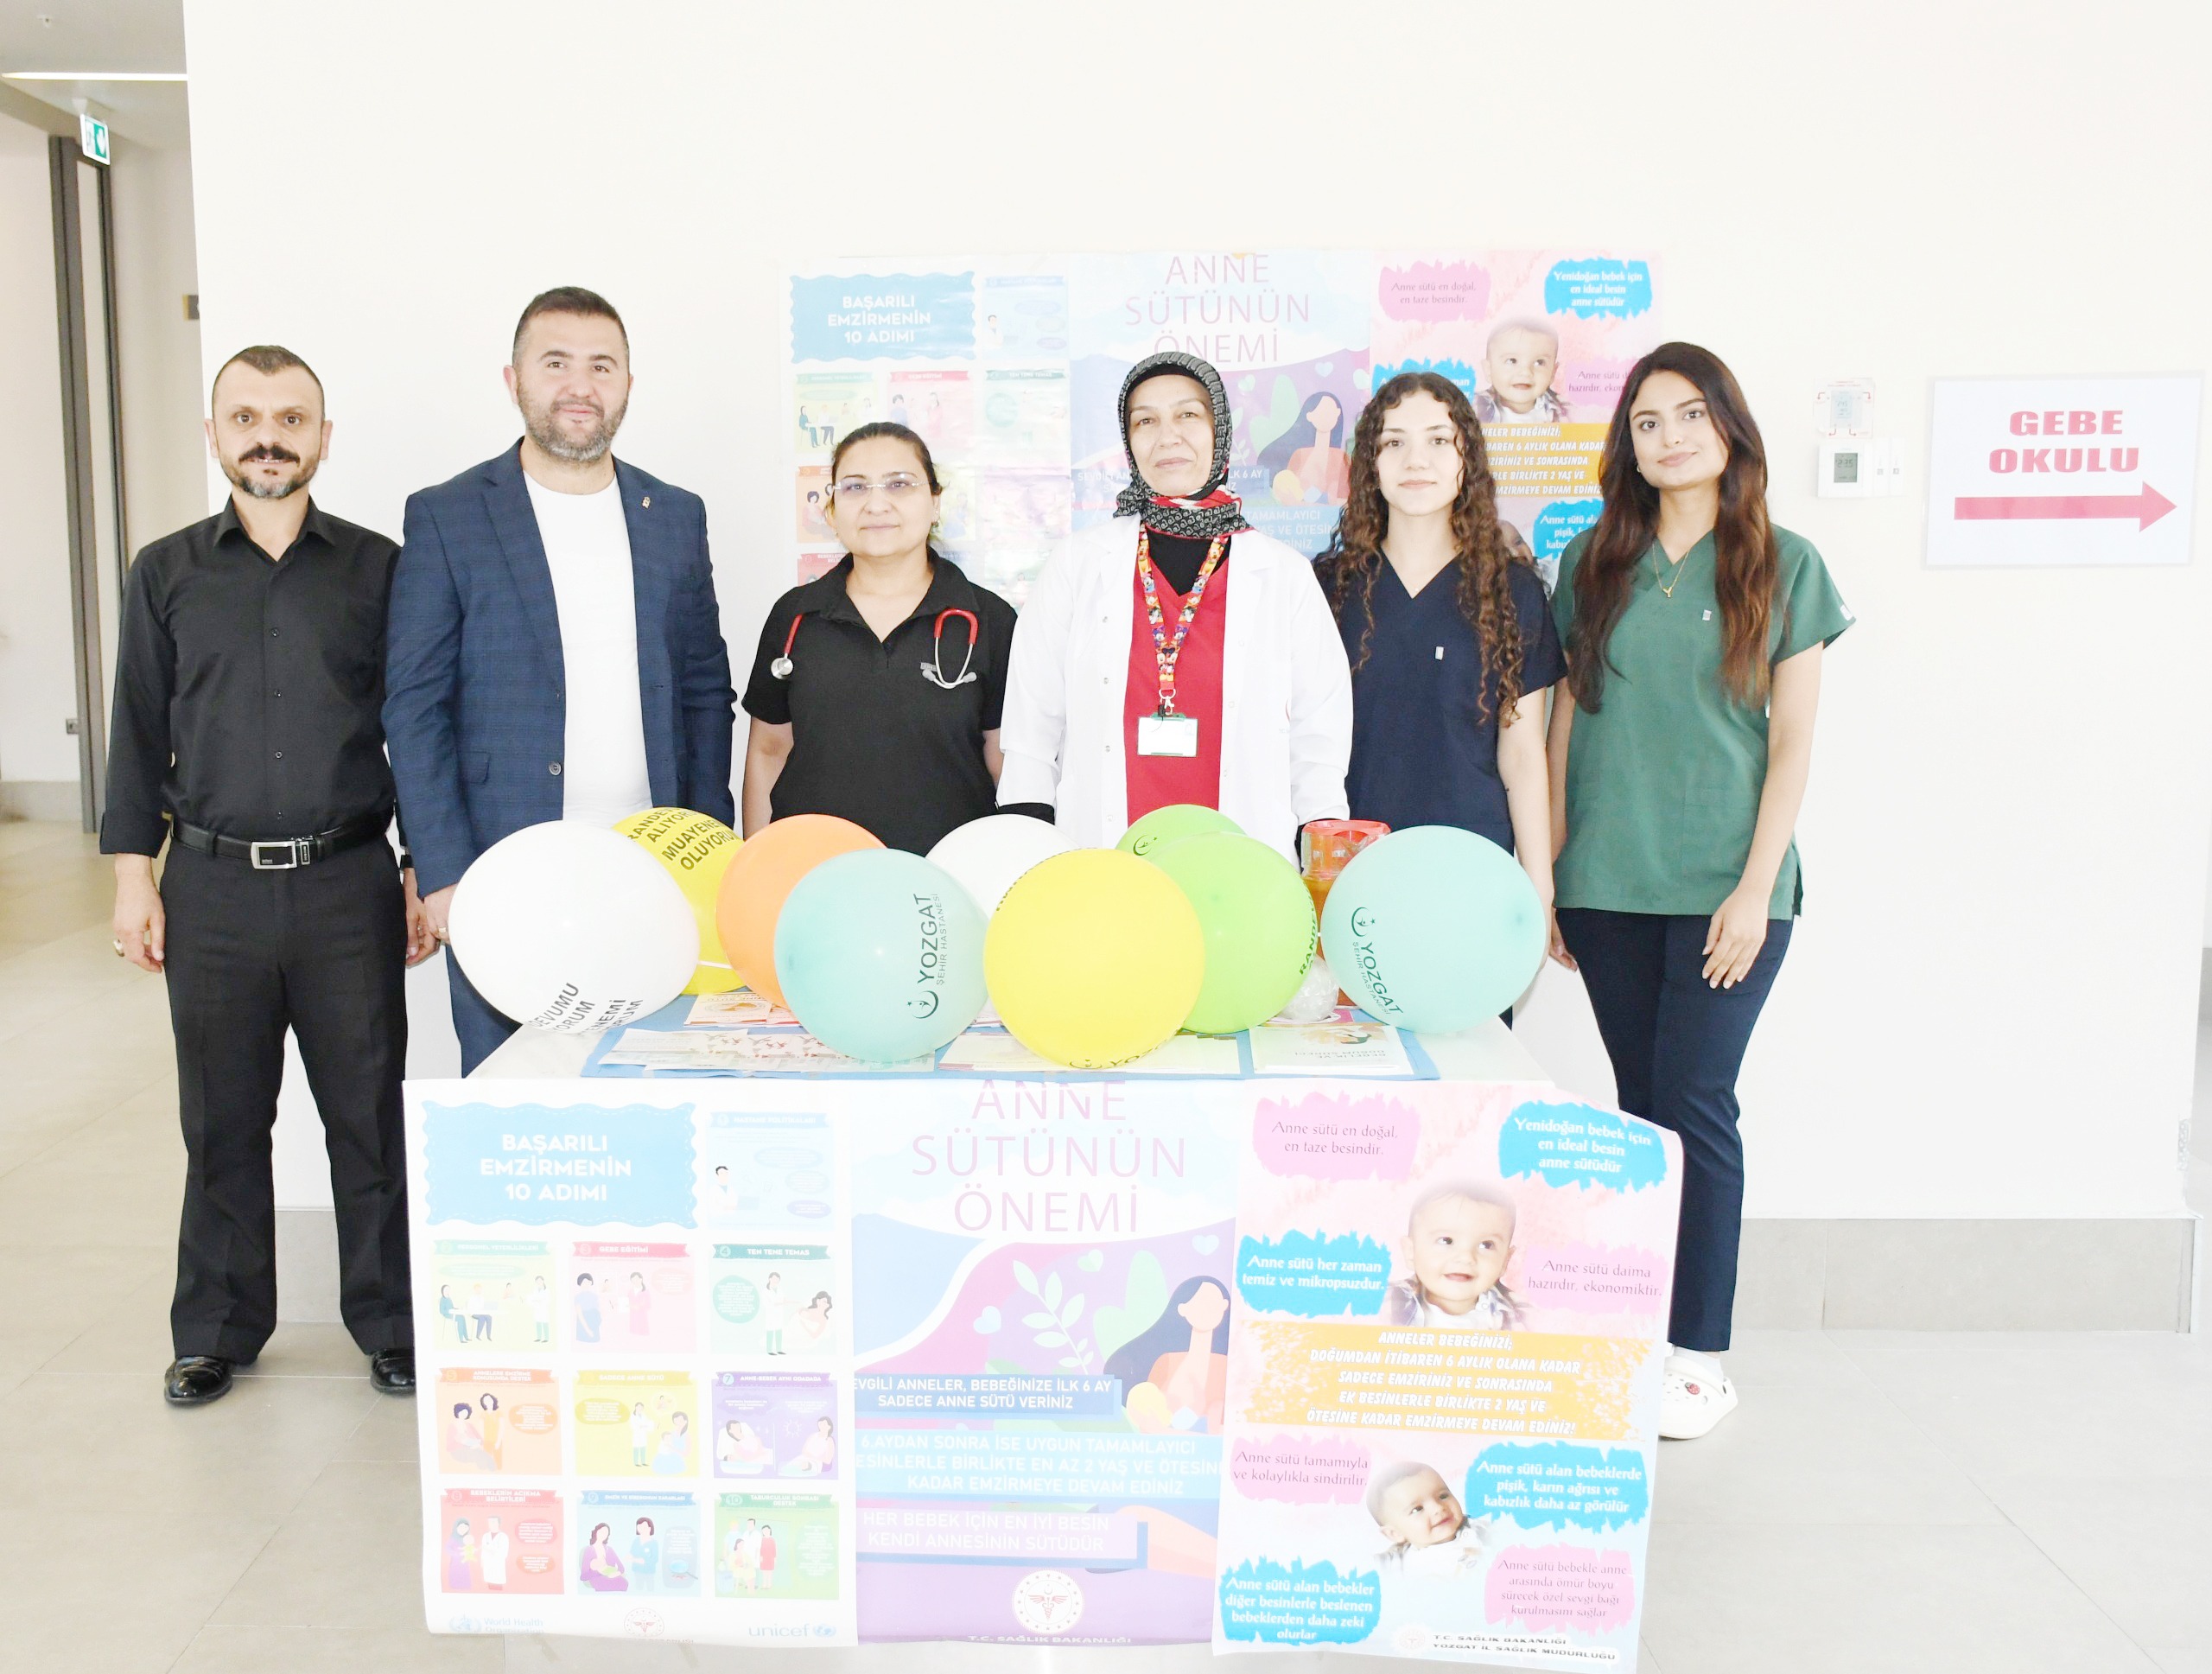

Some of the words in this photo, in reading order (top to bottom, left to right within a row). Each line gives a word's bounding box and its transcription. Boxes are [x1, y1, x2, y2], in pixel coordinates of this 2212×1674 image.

[1165, 254, 1269, 284] ANNE
[1553, 271, 1600, 283] Yenidoğan
[1600, 271, 1625, 281] bebek
[1626, 272, 1643, 283] için
[1390, 282, 1416, 291] Anne
[1418, 283, 1436, 291] sütü
[1451, 282, 1476, 292] doğal,
[1569, 285, 1581, 294] en
[1582, 284, 1603, 294] ideal
[1604, 284, 1626, 294] besin
[842, 295, 916, 311] BAŞARILI
[1125, 289, 1309, 327] SÜTÜNÜN
[1412, 295, 1429, 303] taze
[1432, 295, 1467, 303] besindir.
[1570, 298, 1592, 307] anne
[1593, 296, 1624, 307] sütüdür
[828, 310, 931, 328] EMZİRMENİN
[844, 330, 862, 343] 10
[868, 330, 914, 343] ADIMI
[1577, 370, 1602, 380] Anne
[2009, 411, 2123, 436] GEBE
[1524, 442, 1548, 452] AYLIK
[1550, 442, 1577, 451] OLANA
[1524, 456, 1534, 466] VE
[1536, 456, 1588, 466] SONRASINDA
[1989, 448, 2139, 474] OKULU
[1251, 469, 1263, 480] AY
[1510, 470, 1548, 481] BİRLİKTE
[1540, 515, 1565, 525] Anne
[1567, 514, 1585, 525] sütü
[930, 893, 948, 950] HASTANESİ
[913, 894, 938, 984] YOZGAT
[1352, 941, 1363, 969] ŞEHİR
[936, 954, 948, 986] ŞEHİR
[1361, 941, 1403, 1013] YOZGAT
[971, 1081, 1127, 1120] ANNE
[1271, 1120, 1308, 1135] Anne
[1312, 1123, 1338, 1136] sütü
[1341, 1127, 1357, 1136] en
[1361, 1124, 1397, 1139] doğal,
[1514, 1117, 1584, 1136] Yenidoğan
[1588, 1123, 1624, 1140] bebek
[1628, 1131, 1651, 1145] için
[502, 1133, 609, 1156] BAŞARILI
[912, 1127, 1185, 1178] SÜTÜNÜN
[1283, 1143, 1299, 1152] en
[1303, 1141, 1327, 1153] taze
[1332, 1142, 1382, 1154] besindir.
[1537, 1139, 1554, 1150] en
[1556, 1137, 1588, 1152] ideal
[1591, 1139, 1625, 1156] besin
[480, 1155, 632, 1177] EMZİRMENİN
[1538, 1158, 1572, 1169] anne
[1573, 1157, 1622, 1173] sütüdür
[505, 1182, 531, 1202] 10
[538, 1182, 608, 1202] ADIMI
[954, 1182, 1137, 1232] ÖNEMİ
[1246, 1254, 1285, 1269] Anne
[1287, 1257, 1314, 1270] sütü
[1316, 1257, 1338, 1271] her
[1339, 1261, 1382, 1273] zaman
[1542, 1259, 1579, 1273] Anne
[1582, 1263, 1608, 1275] sütü
[1611, 1263, 1650, 1277] daima
[1242, 1273, 1276, 1286] temiz
[1278, 1276, 1295, 1287] ve
[1297, 1274, 1385, 1291] mikropsuzdur.
[1529, 1276, 1579, 1290] hazırdır,
[1583, 1279, 1662, 1296] ekonomiktir.
[1377, 1331, 1436, 1346] ANNELER
[1437, 1332, 1513, 1351] BEBEĞİNİZİ;
[1309, 1348, 1382, 1365] DOĞUMDAN
[1383, 1351, 1445, 1367] İTİBAREN
[1445, 1354, 1455, 1368] 6
[1456, 1354, 1494, 1370] AYLIK
[1495, 1357, 1536, 1372] OLANA
[1538, 1359, 1581, 1374] KADAR
[896, 1378, 967, 1392] ANNELER,
[970, 1377, 1052, 1392] BEBEĞİNİZE
[1056, 1377, 1079, 1392] İLK
[1082, 1379, 1090, 1392] 6
[1093, 1379, 1111, 1392] AY
[877, 1394, 932, 1407] SADECE
[936, 1395, 976, 1408] ANNE
[979, 1393, 1015, 1408] SÜTÜ
[1018, 1393, 1073, 1409] VERİNİZ
[1235, 1450, 1271, 1464] Anne
[1274, 1454, 1300, 1465] sütü
[1304, 1454, 1368, 1470] tamamıyla
[1232, 1470, 1248, 1480] ve
[1250, 1468, 1309, 1484] kolaylıkla
[1313, 1472, 1367, 1486] sindirilir.
[863, 1511, 898, 1526] HER
[903, 1512, 960, 1528] BEBEK
[966, 1512, 998, 1530] İÇİN
[1004, 1514, 1027, 1530] EN
[1033, 1512, 1052, 1530] İYİ
[1058, 1513, 1109, 1531] BESİN
[868, 1531, 919, 1547] KENDİ
[925, 1531, 1020, 1550] ANNESİNİN
[1025, 1533, 1103, 1551] SÜTÜDÜR
[484, 1617, 512, 1626] World
[513, 1618, 544, 1626] Health
[748, 1623, 810, 1639] unicef
[1457, 1633, 1499, 1642] SAĞLIK
[1541, 1646, 1615, 1659] MÜDÜRLÜĞÜ
